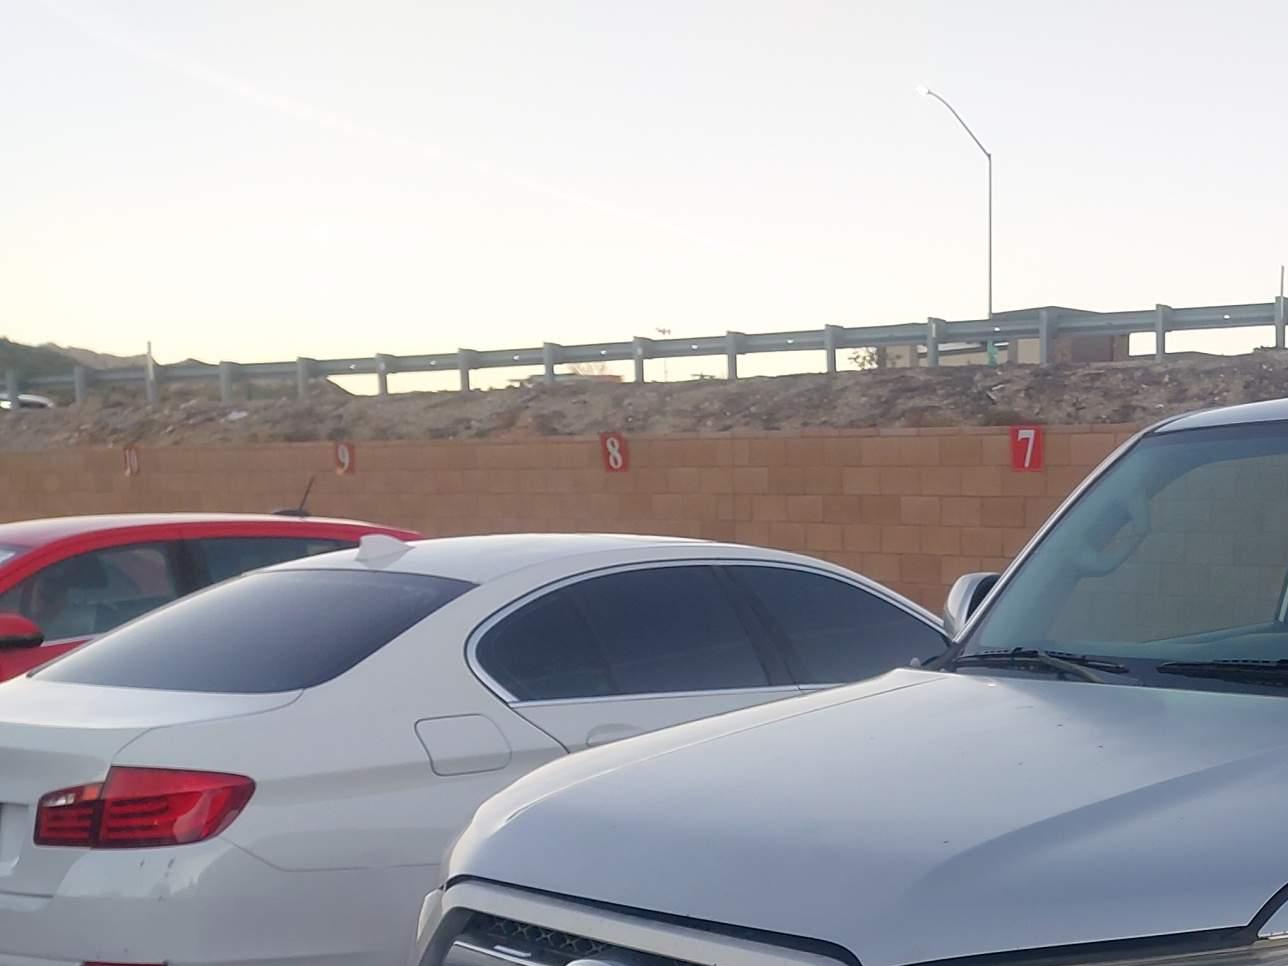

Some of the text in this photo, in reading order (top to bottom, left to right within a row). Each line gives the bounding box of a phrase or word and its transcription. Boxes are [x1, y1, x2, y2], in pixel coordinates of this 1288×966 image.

[337, 444, 350, 474] 9
[606, 437, 623, 469] 8
[1017, 429, 1035, 468] 7
